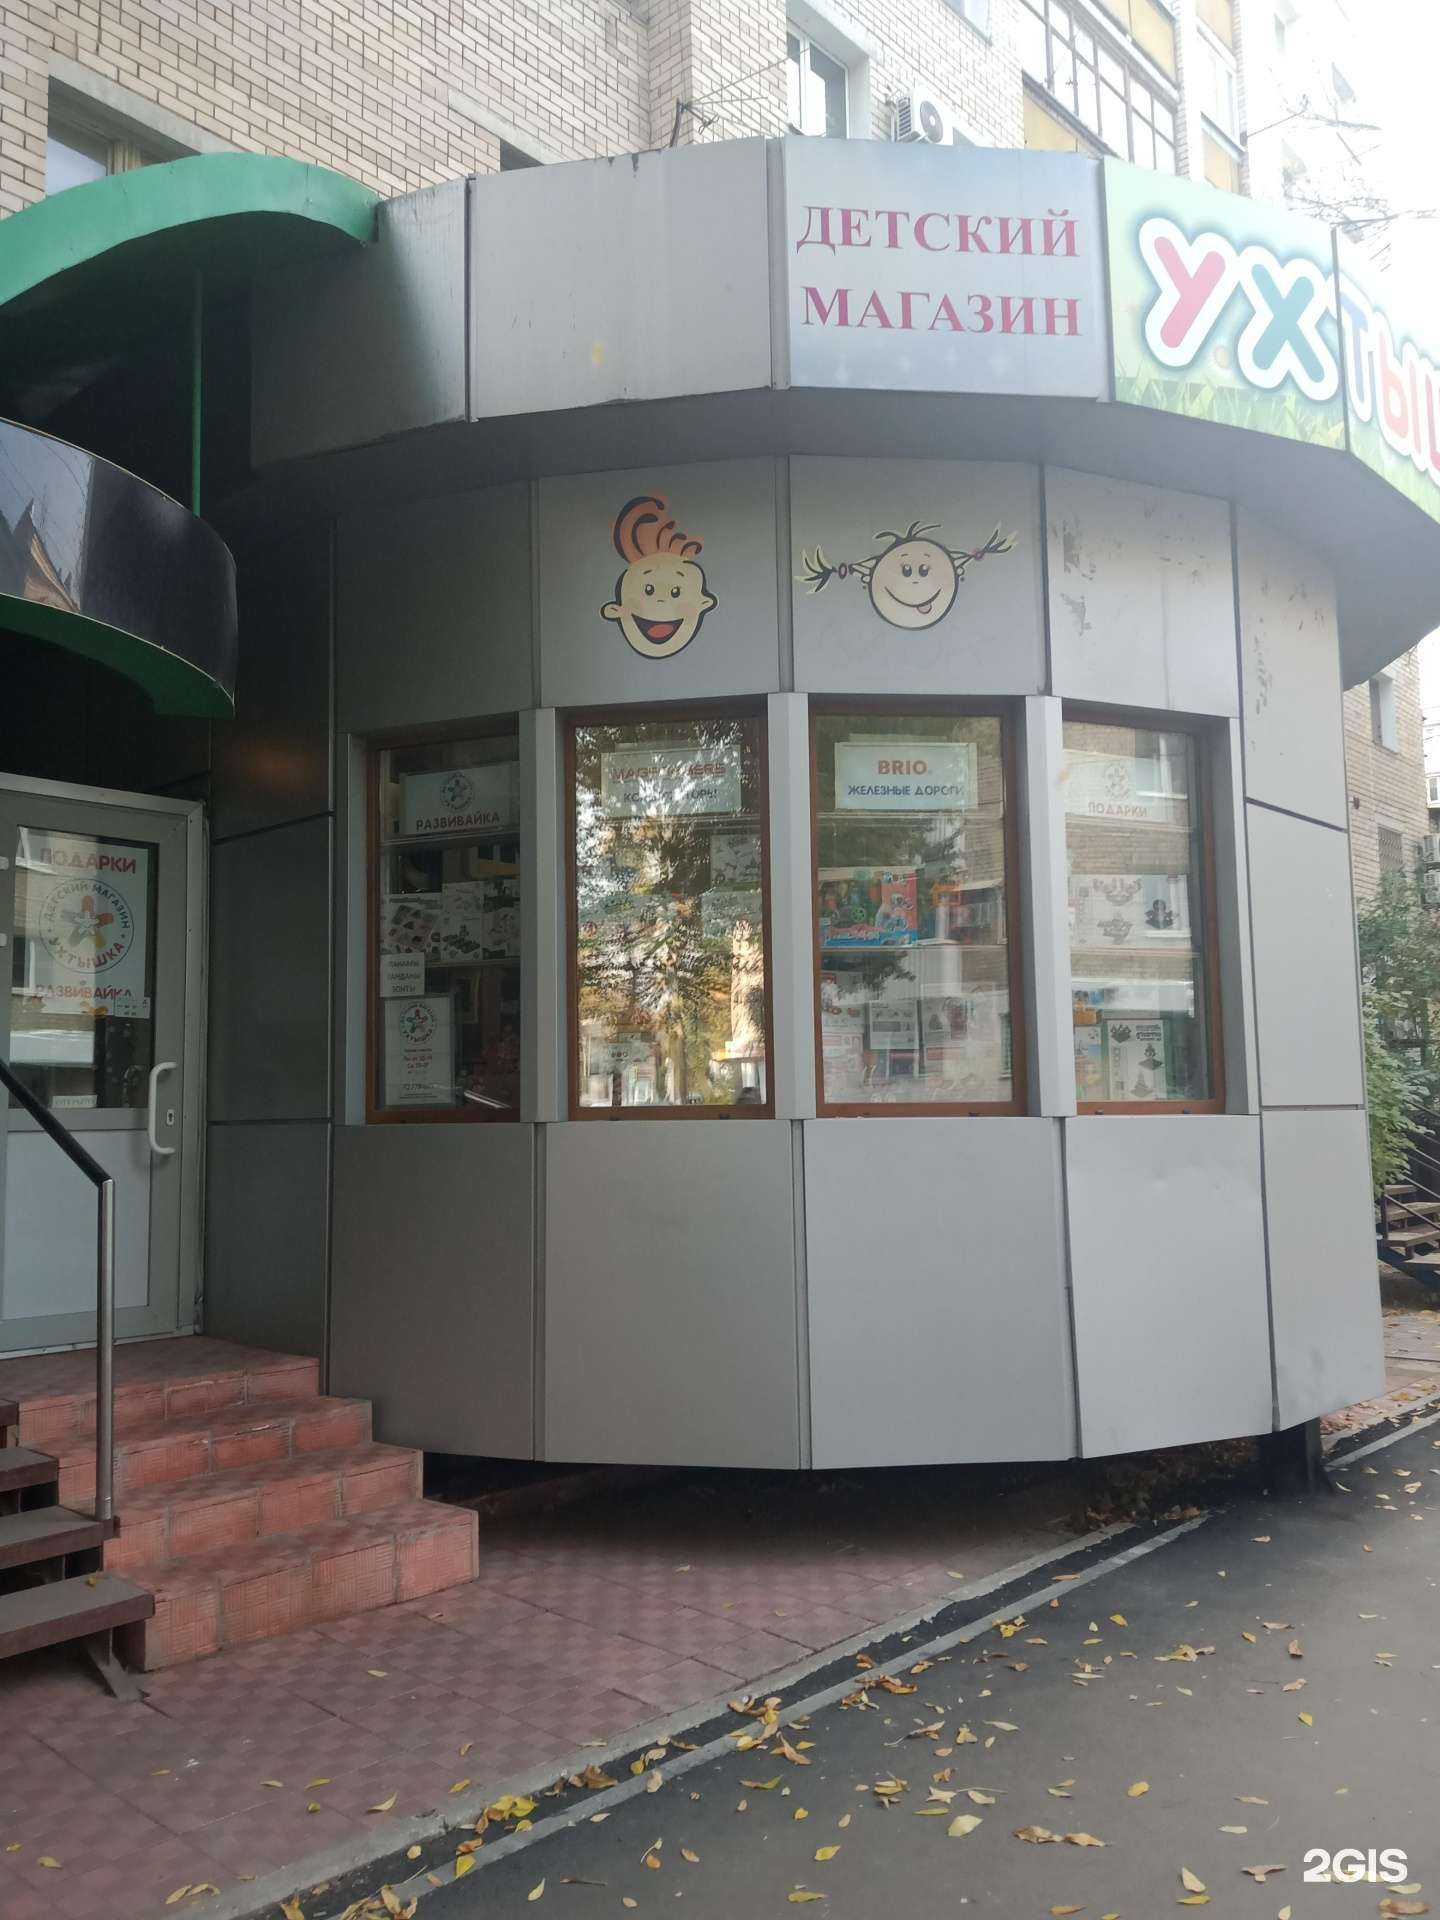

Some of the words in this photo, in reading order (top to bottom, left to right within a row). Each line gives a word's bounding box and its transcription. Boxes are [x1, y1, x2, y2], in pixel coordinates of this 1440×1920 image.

[796, 204, 1081, 259] ДЕТСКИЙ
[801, 286, 1083, 337] МАГАЗИН
[877, 759, 929, 776] BRIO
[848, 784, 911, 797] ЖЕЛЕЗНЫЕ
[914, 784, 964, 798] ДОРОГИ
[415, 810, 501, 831] РАЗВИВАЙКА
[1087, 801, 1148, 818] ПОДАРКИ
[40, 848, 137, 874] ПОДАРКИ
[92, 883, 131, 930] МАГАЗИН
[48, 935, 125, 969] УХТЫШКА
